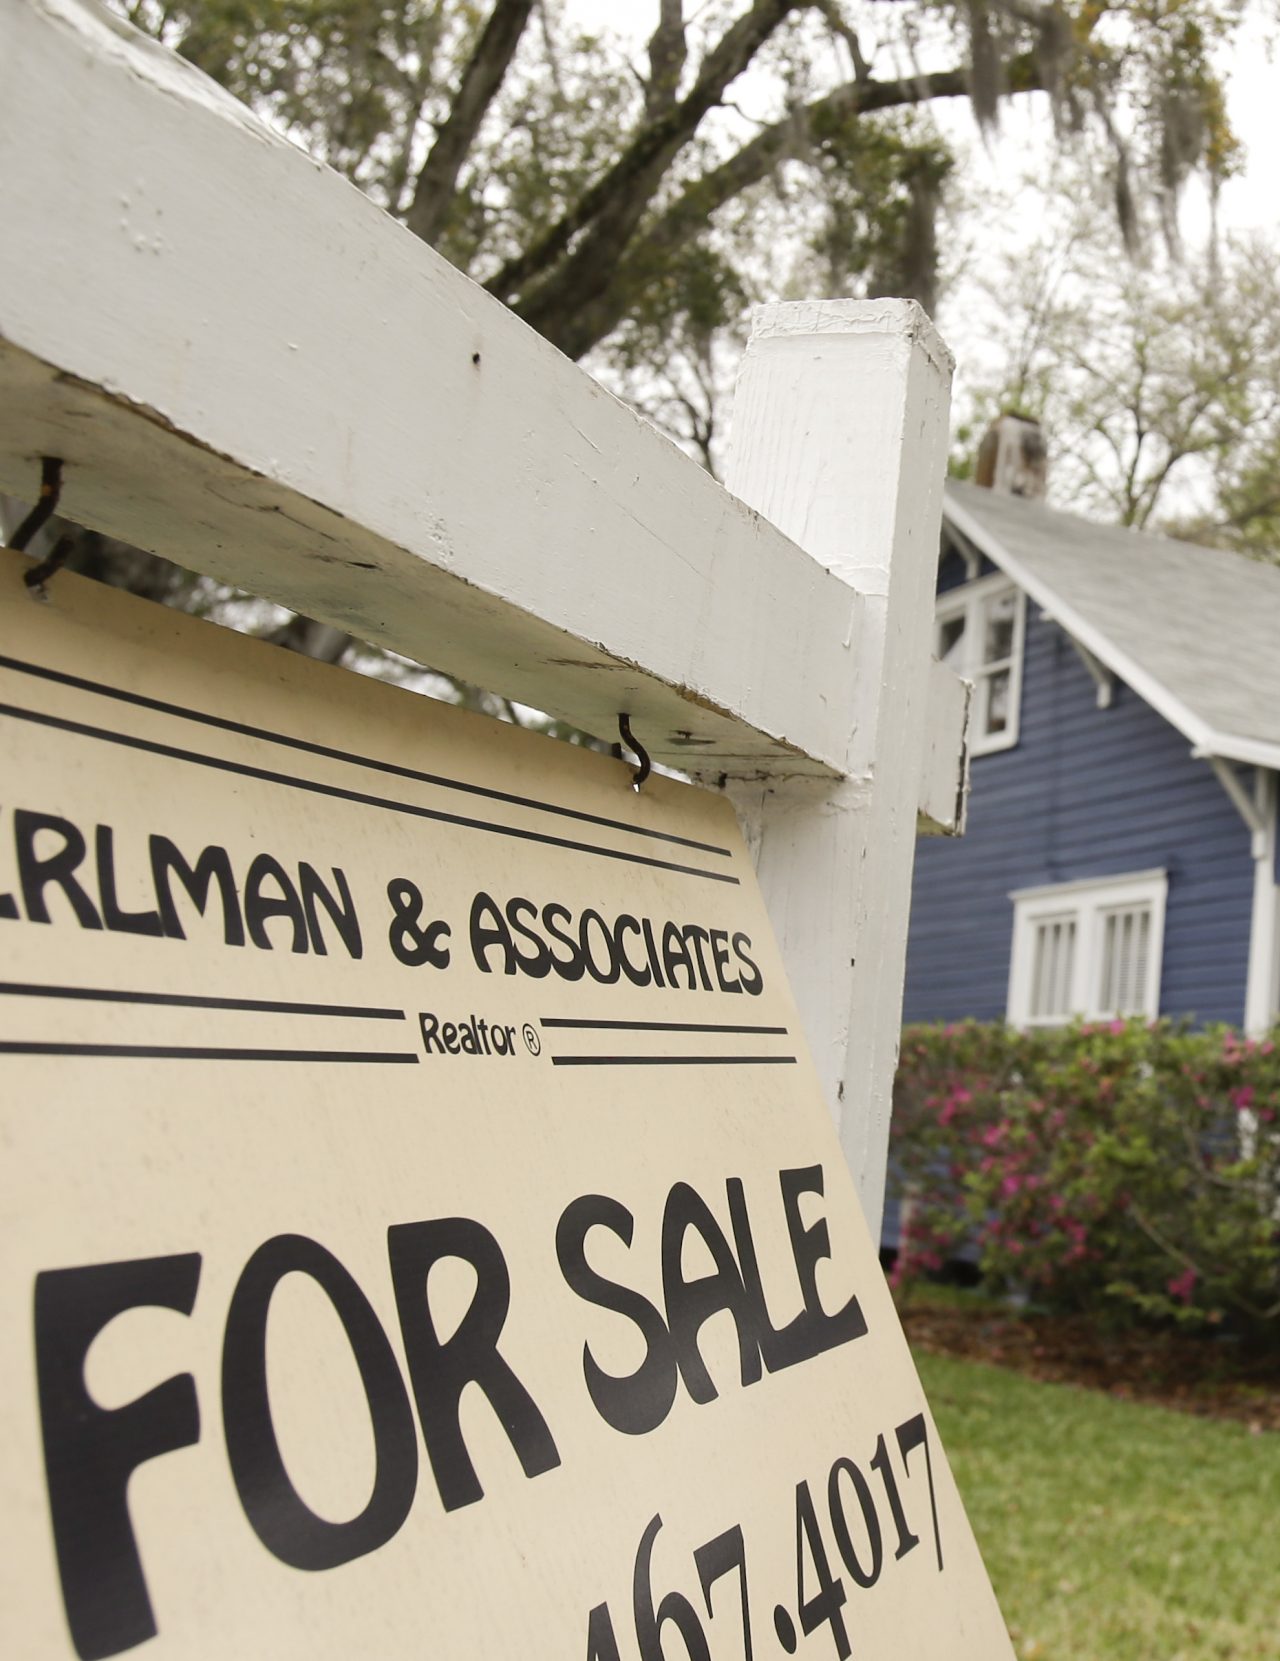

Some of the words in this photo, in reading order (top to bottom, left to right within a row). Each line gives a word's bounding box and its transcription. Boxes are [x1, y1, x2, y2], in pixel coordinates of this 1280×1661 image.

[386, 877, 452, 970] &
[469, 891, 764, 996] ASSOCIATES
[33, 1217, 562, 1661] FOR
[555, 1163, 869, 1436] SALE
[586, 1412, 945, 1661] 67.4017
